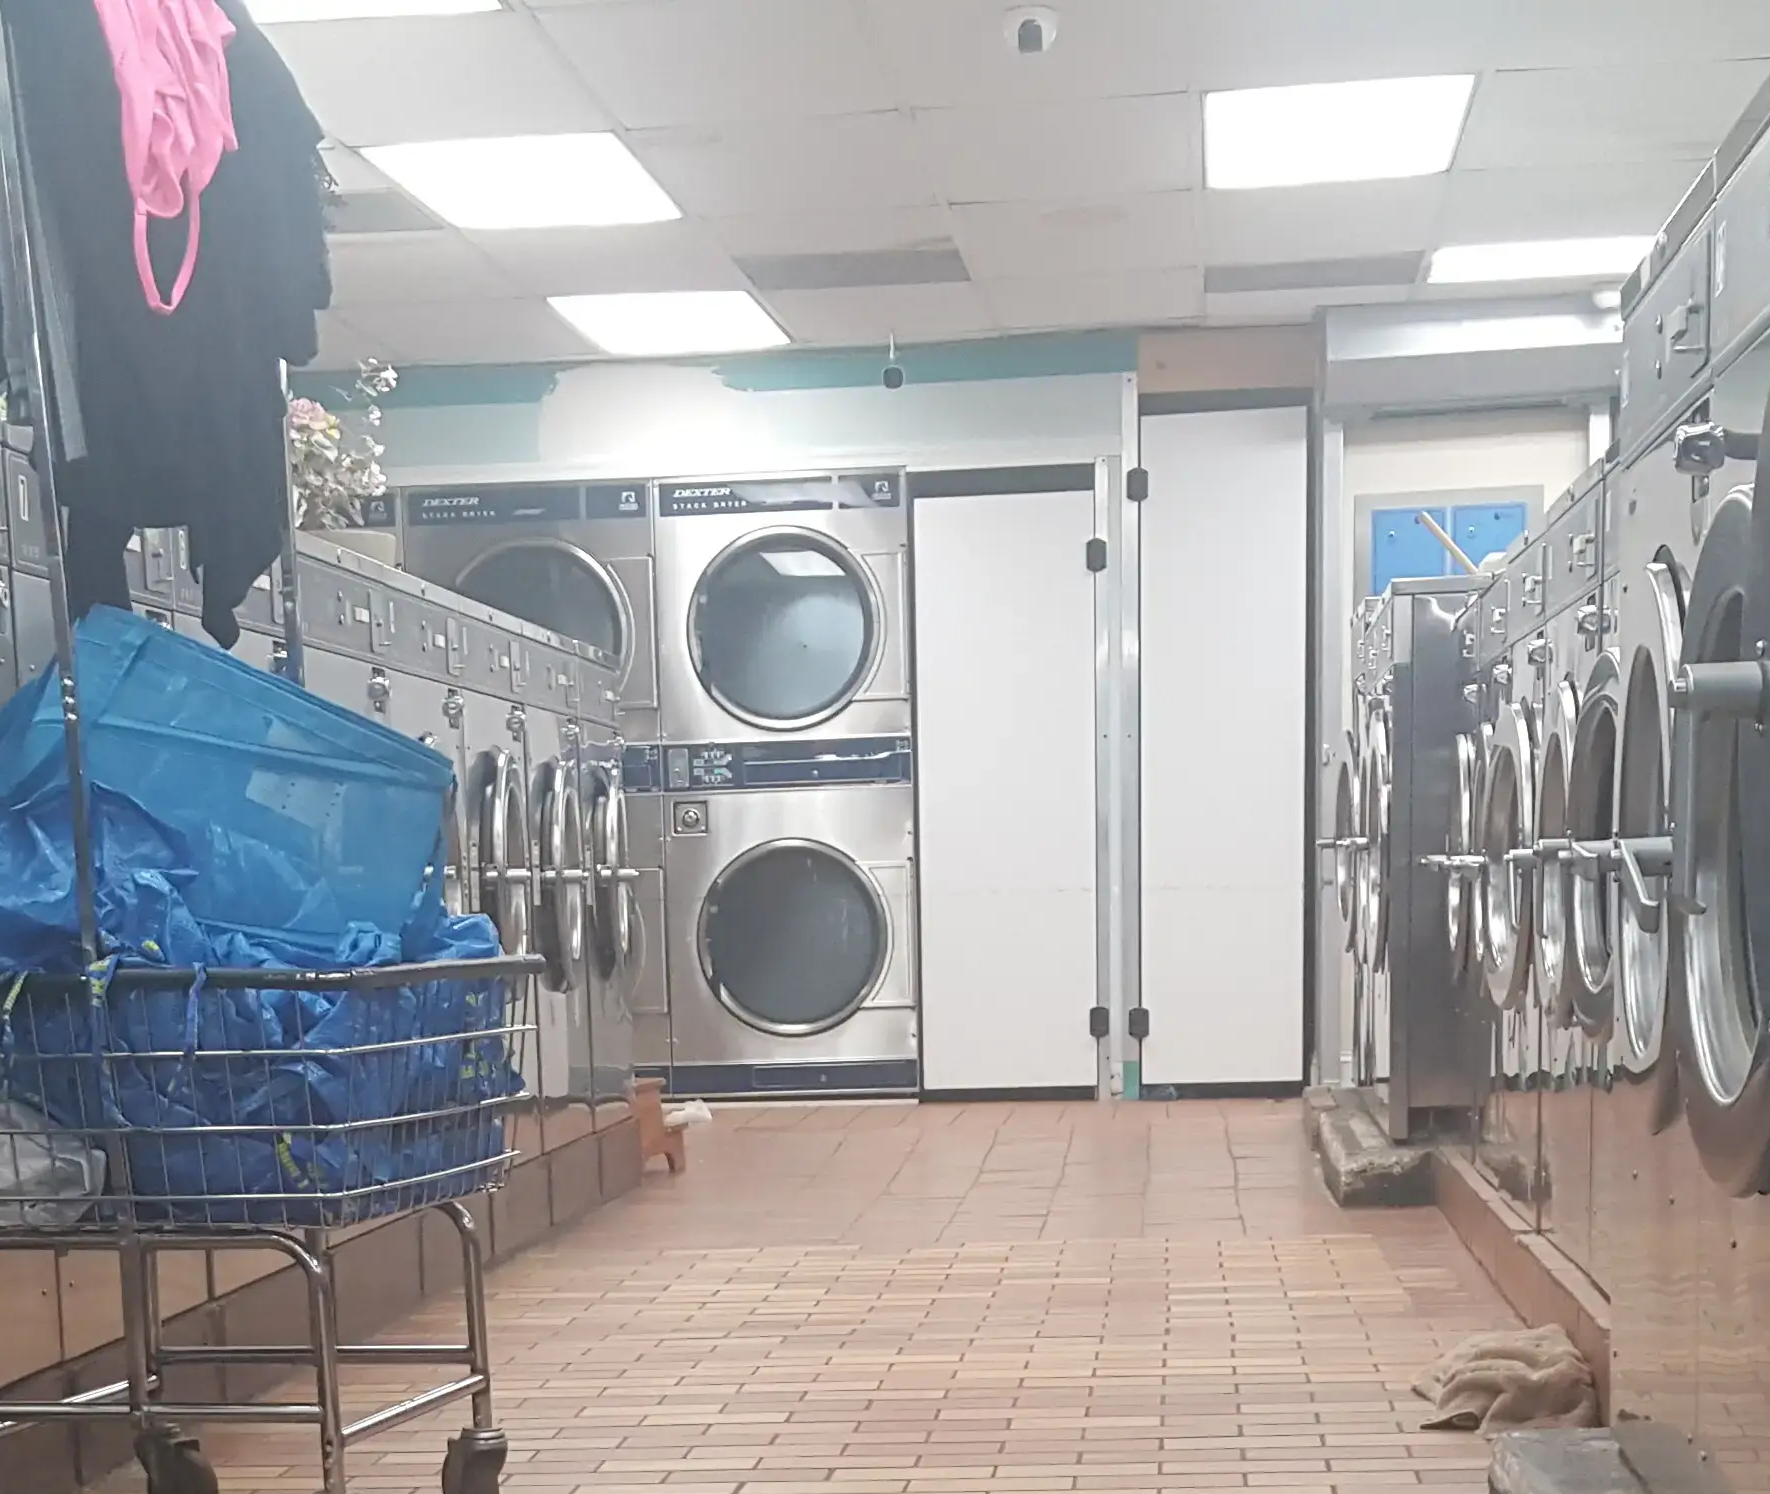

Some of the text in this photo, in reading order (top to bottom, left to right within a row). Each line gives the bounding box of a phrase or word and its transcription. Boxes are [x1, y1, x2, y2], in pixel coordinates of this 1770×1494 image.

[673, 487, 731, 498] DEXTER
[422, 496, 480, 507] DEXTER
[672, 500, 747, 510] STACK DRYER
